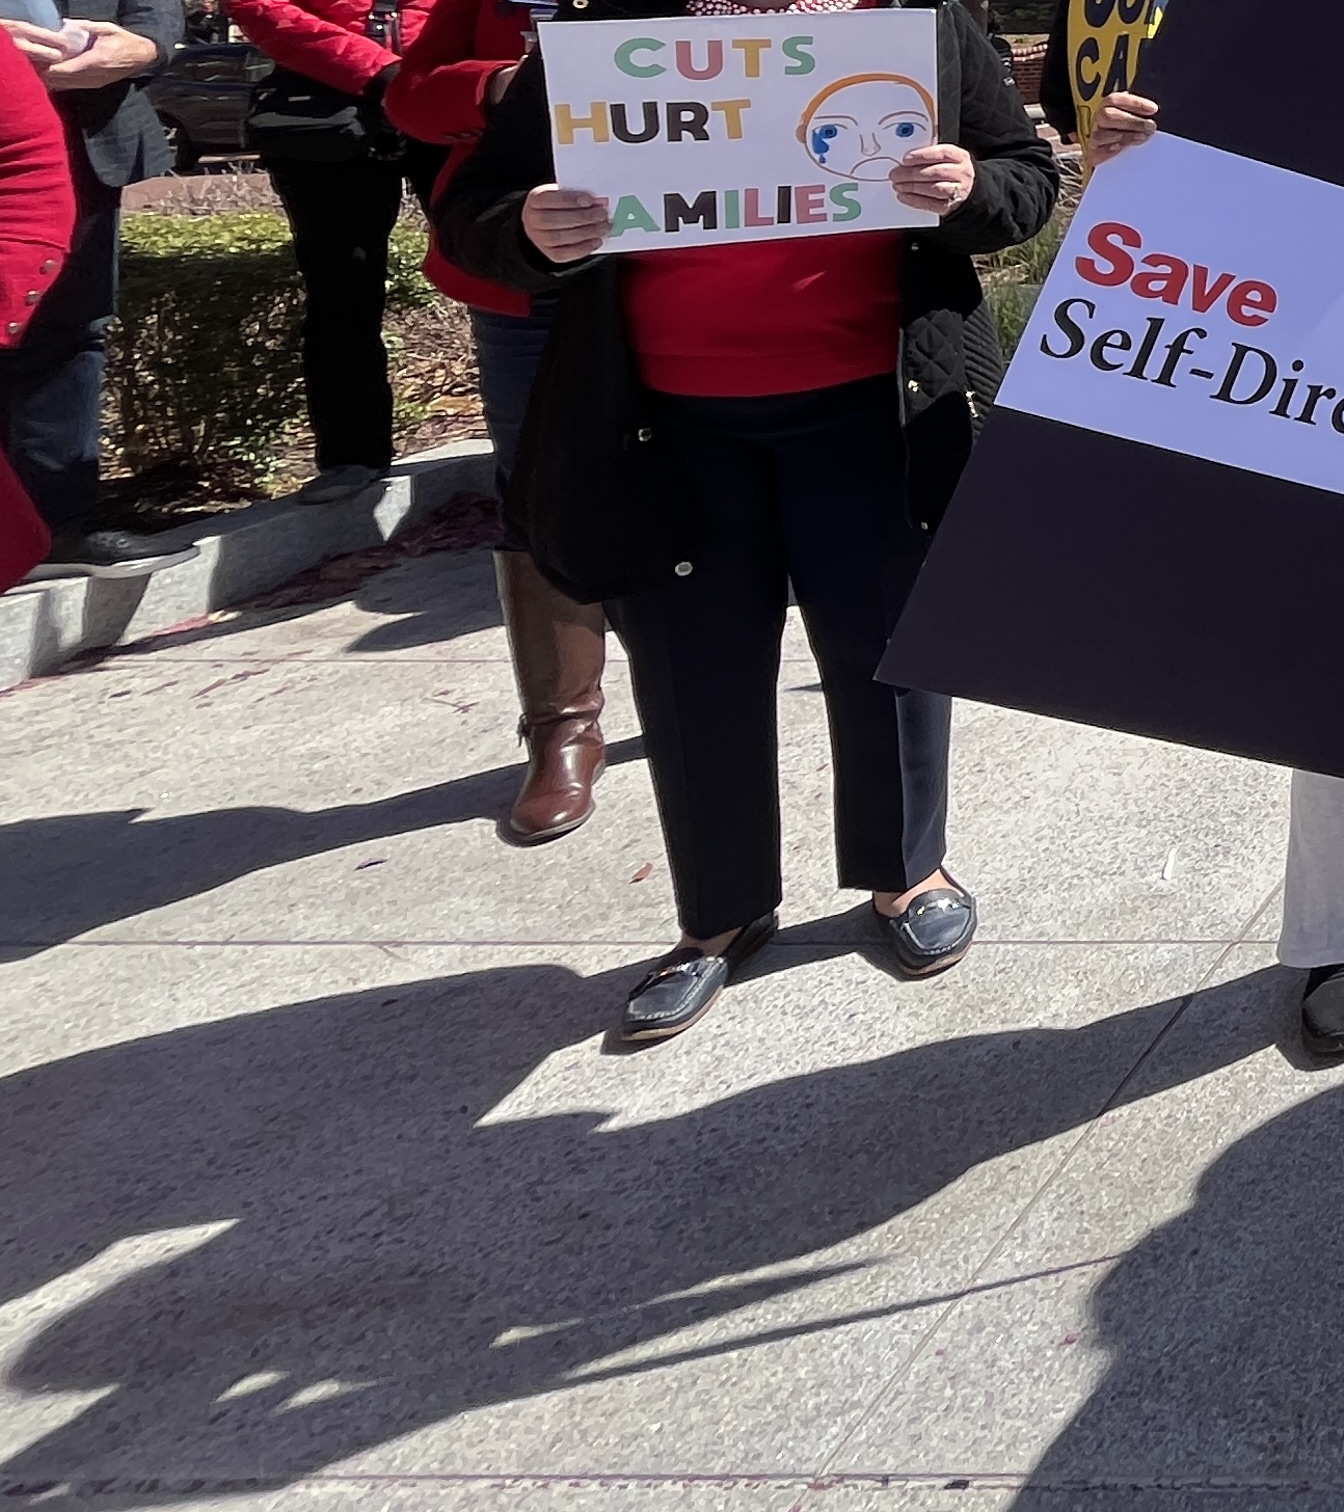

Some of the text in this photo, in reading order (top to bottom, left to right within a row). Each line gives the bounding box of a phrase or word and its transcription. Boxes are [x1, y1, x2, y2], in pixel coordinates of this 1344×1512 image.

[614, 35, 816, 80] CUTS
[554, 99, 752, 144] HURT
[596, 182, 862, 238] AMILIES
[1075, 222, 1278, 327] Save
